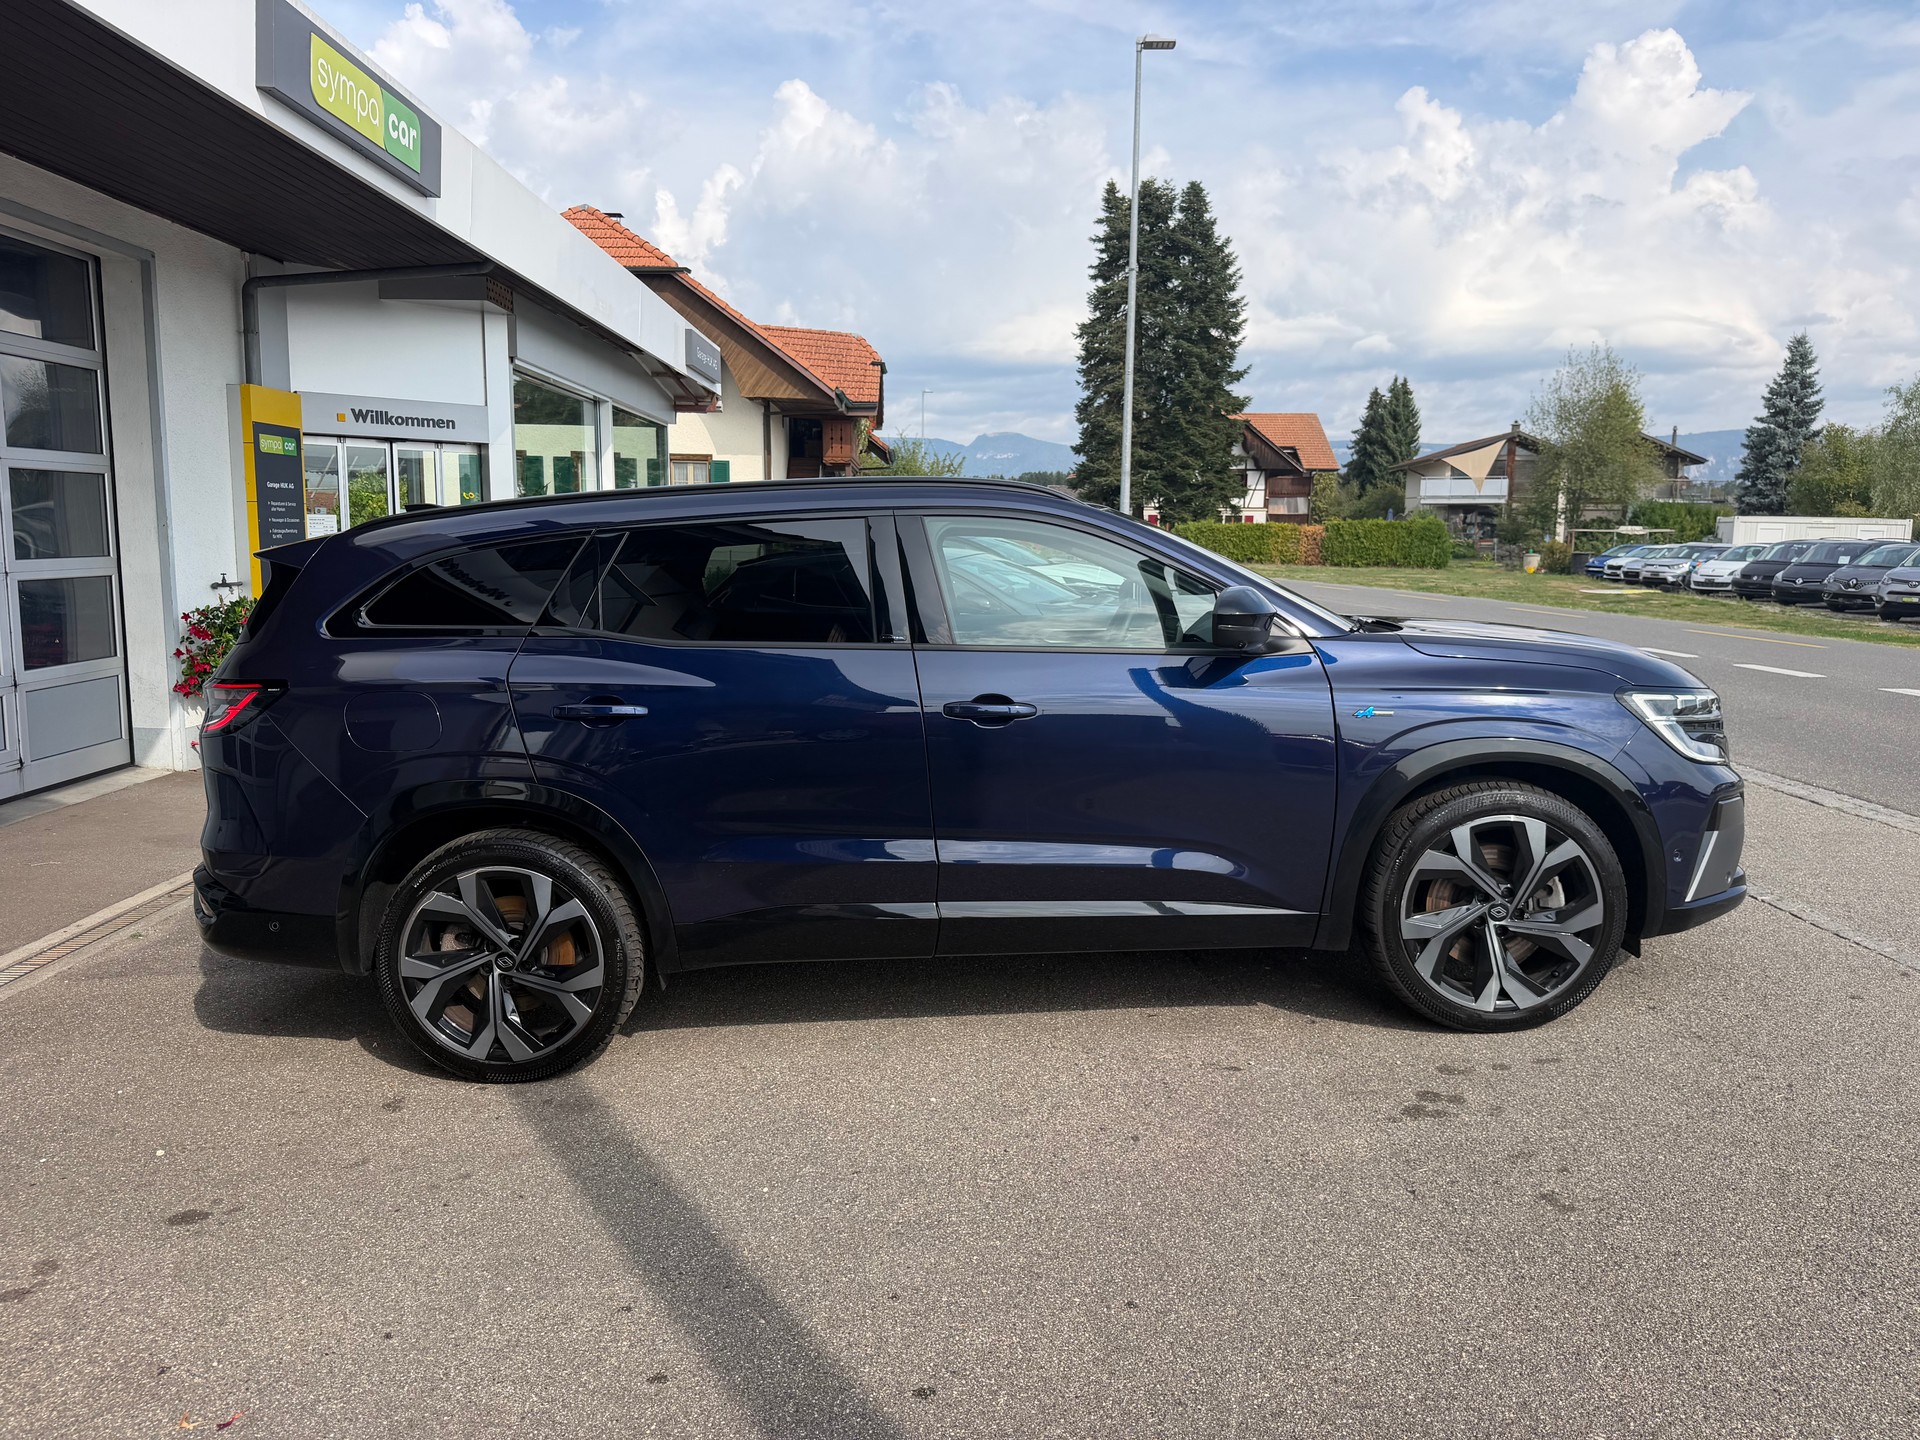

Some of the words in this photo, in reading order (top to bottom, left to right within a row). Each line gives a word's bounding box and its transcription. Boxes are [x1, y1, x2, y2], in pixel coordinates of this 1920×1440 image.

[317, 57, 380, 127] sympa
[388, 113, 417, 150] car
[350, 408, 456, 430] Willkommen
[260, 439, 282, 451] sympa
[284, 442, 295, 450] car
